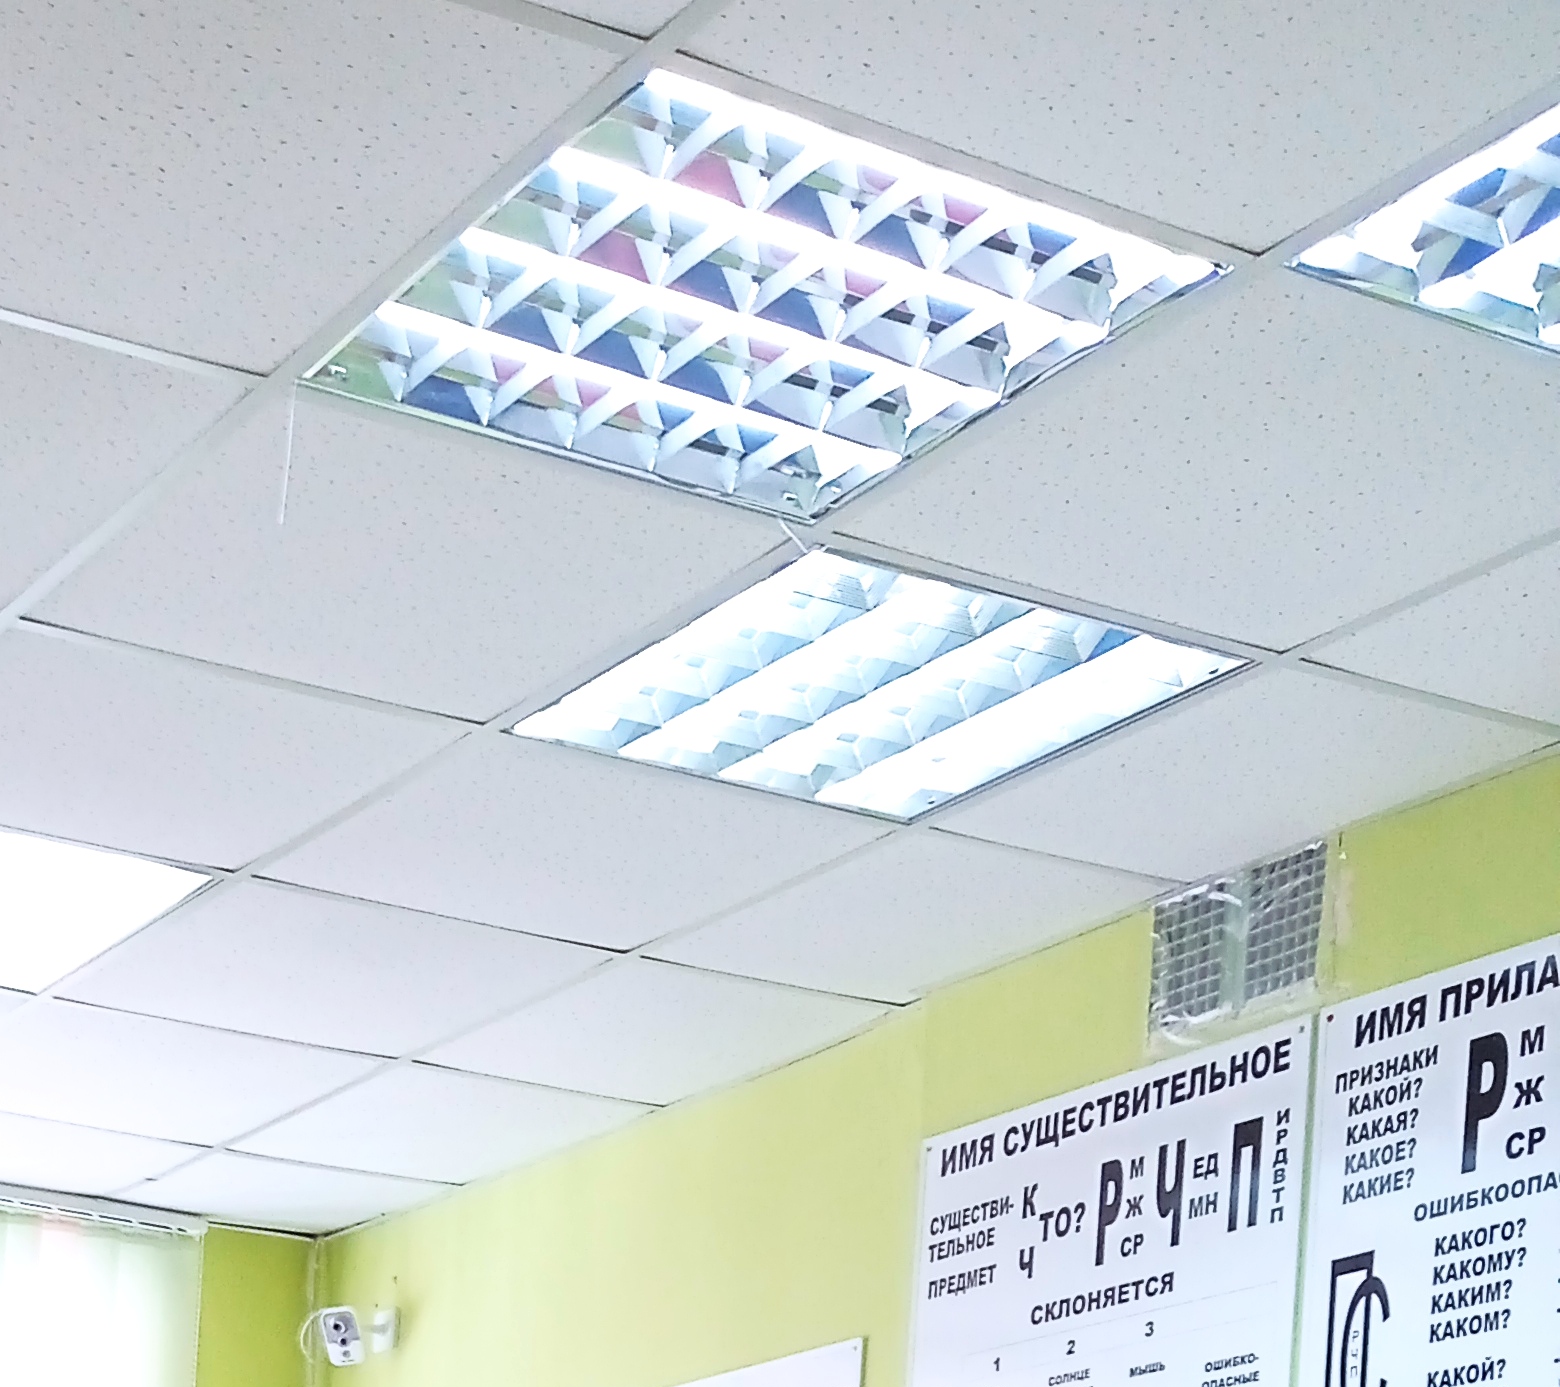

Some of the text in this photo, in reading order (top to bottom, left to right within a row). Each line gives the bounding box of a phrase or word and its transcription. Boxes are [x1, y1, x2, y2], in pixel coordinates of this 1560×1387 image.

[1354, 994, 1428, 1049] ИМЯ
[1334, 1044, 1439, 1095] ПРИЗНАКИ
[940, 1037, 1292, 1178] ИМЯ СУЩЕСТВИТЕЛЬНОЕ
[1347, 1076, 1424, 1118] КАКОЙ?
[1345, 1107, 1420, 1147] КАКАЯ?
[1505, 1126, 1547, 1160] СР
[1192, 1152, 1219, 1181] ЕД
[1344, 1137, 1418, 1176] КАКОЕ?
[1188, 1191, 1219, 1220] МН
[1341, 1167, 1416, 1206] КАКИЕ?
[1413, 1171, 1560, 1222] ОШИБКООПА
[929, 1195, 1015, 1236] СУЩЕСТВИ-
[928, 1226, 996, 1264] ТЕЛЬНОЕ
[1120, 1233, 1145, 1258] СР
[1433, 1217, 1527, 1258] КАКОГО?
[927, 1263, 997, 1301] ПРЕДМЕТ
[1432, 1246, 1528, 1287] КАКОМУ?
[1030, 1270, 1175, 1326] СКЛОНЯЕТСЯ
[1430, 1278, 1514, 1316] КАКИМ?
[1428, 1308, 1512, 1344] КАКОМ?
[993, 1320, 1155, 1372] 1 2 3
[1204, 1352, 1260, 1373] ОШИБКО-
[1048, 1368, 1091, 1387] СОЛНЦЕ
[1129, 1361, 1166, 1378] МЫШЬ
